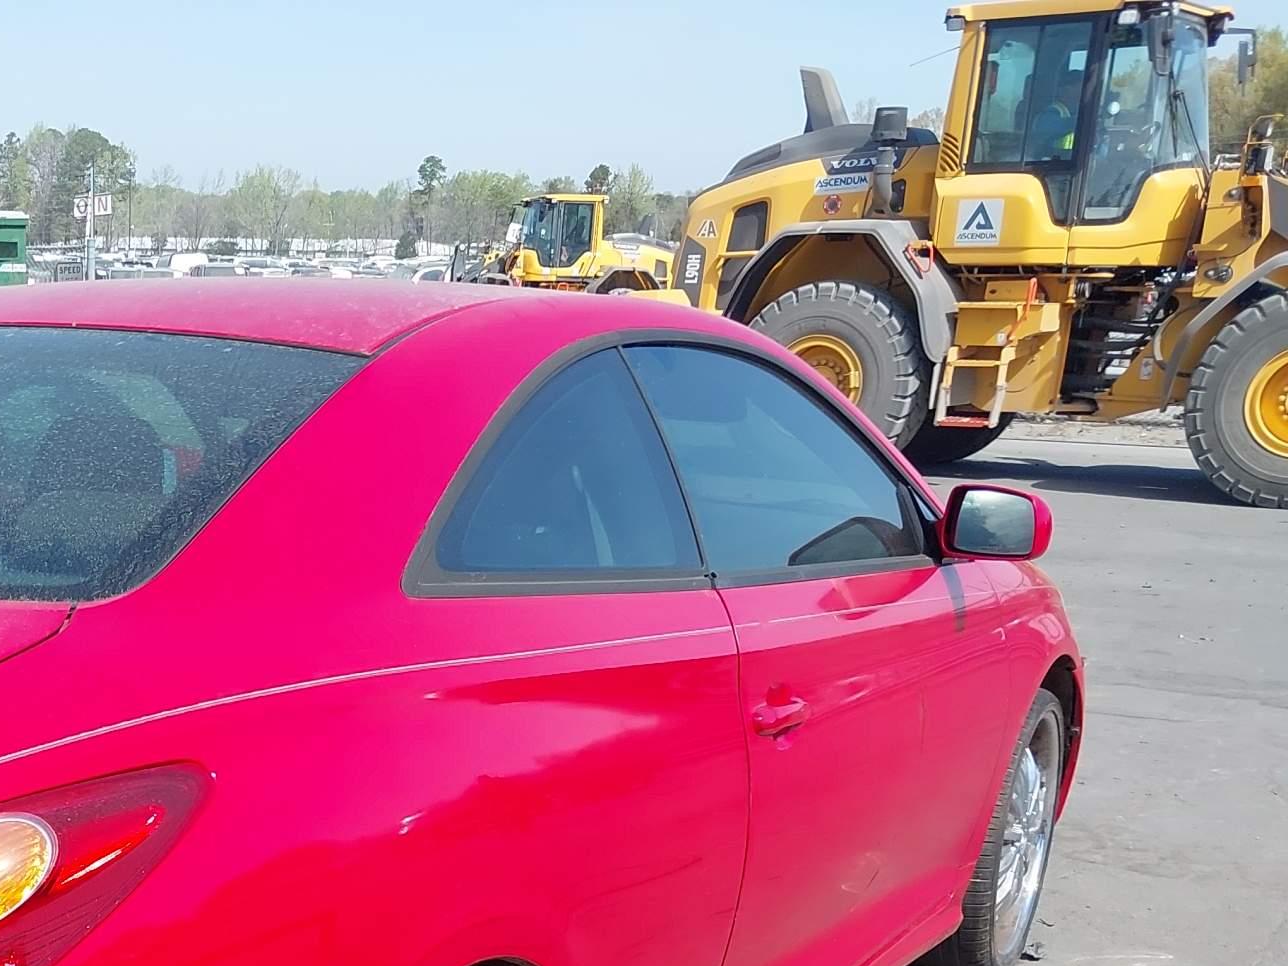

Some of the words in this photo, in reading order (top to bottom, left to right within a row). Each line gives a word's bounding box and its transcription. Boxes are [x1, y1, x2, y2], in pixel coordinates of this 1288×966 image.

[830, 156, 897, 169] VOLV
[815, 176, 869, 188] ASCENDUM
[97, 196, 108, 212] N
[956, 232, 998, 240] ASCENDUM
[59, 266, 81, 275] SPEED
[684, 254, 701, 284] L90H
